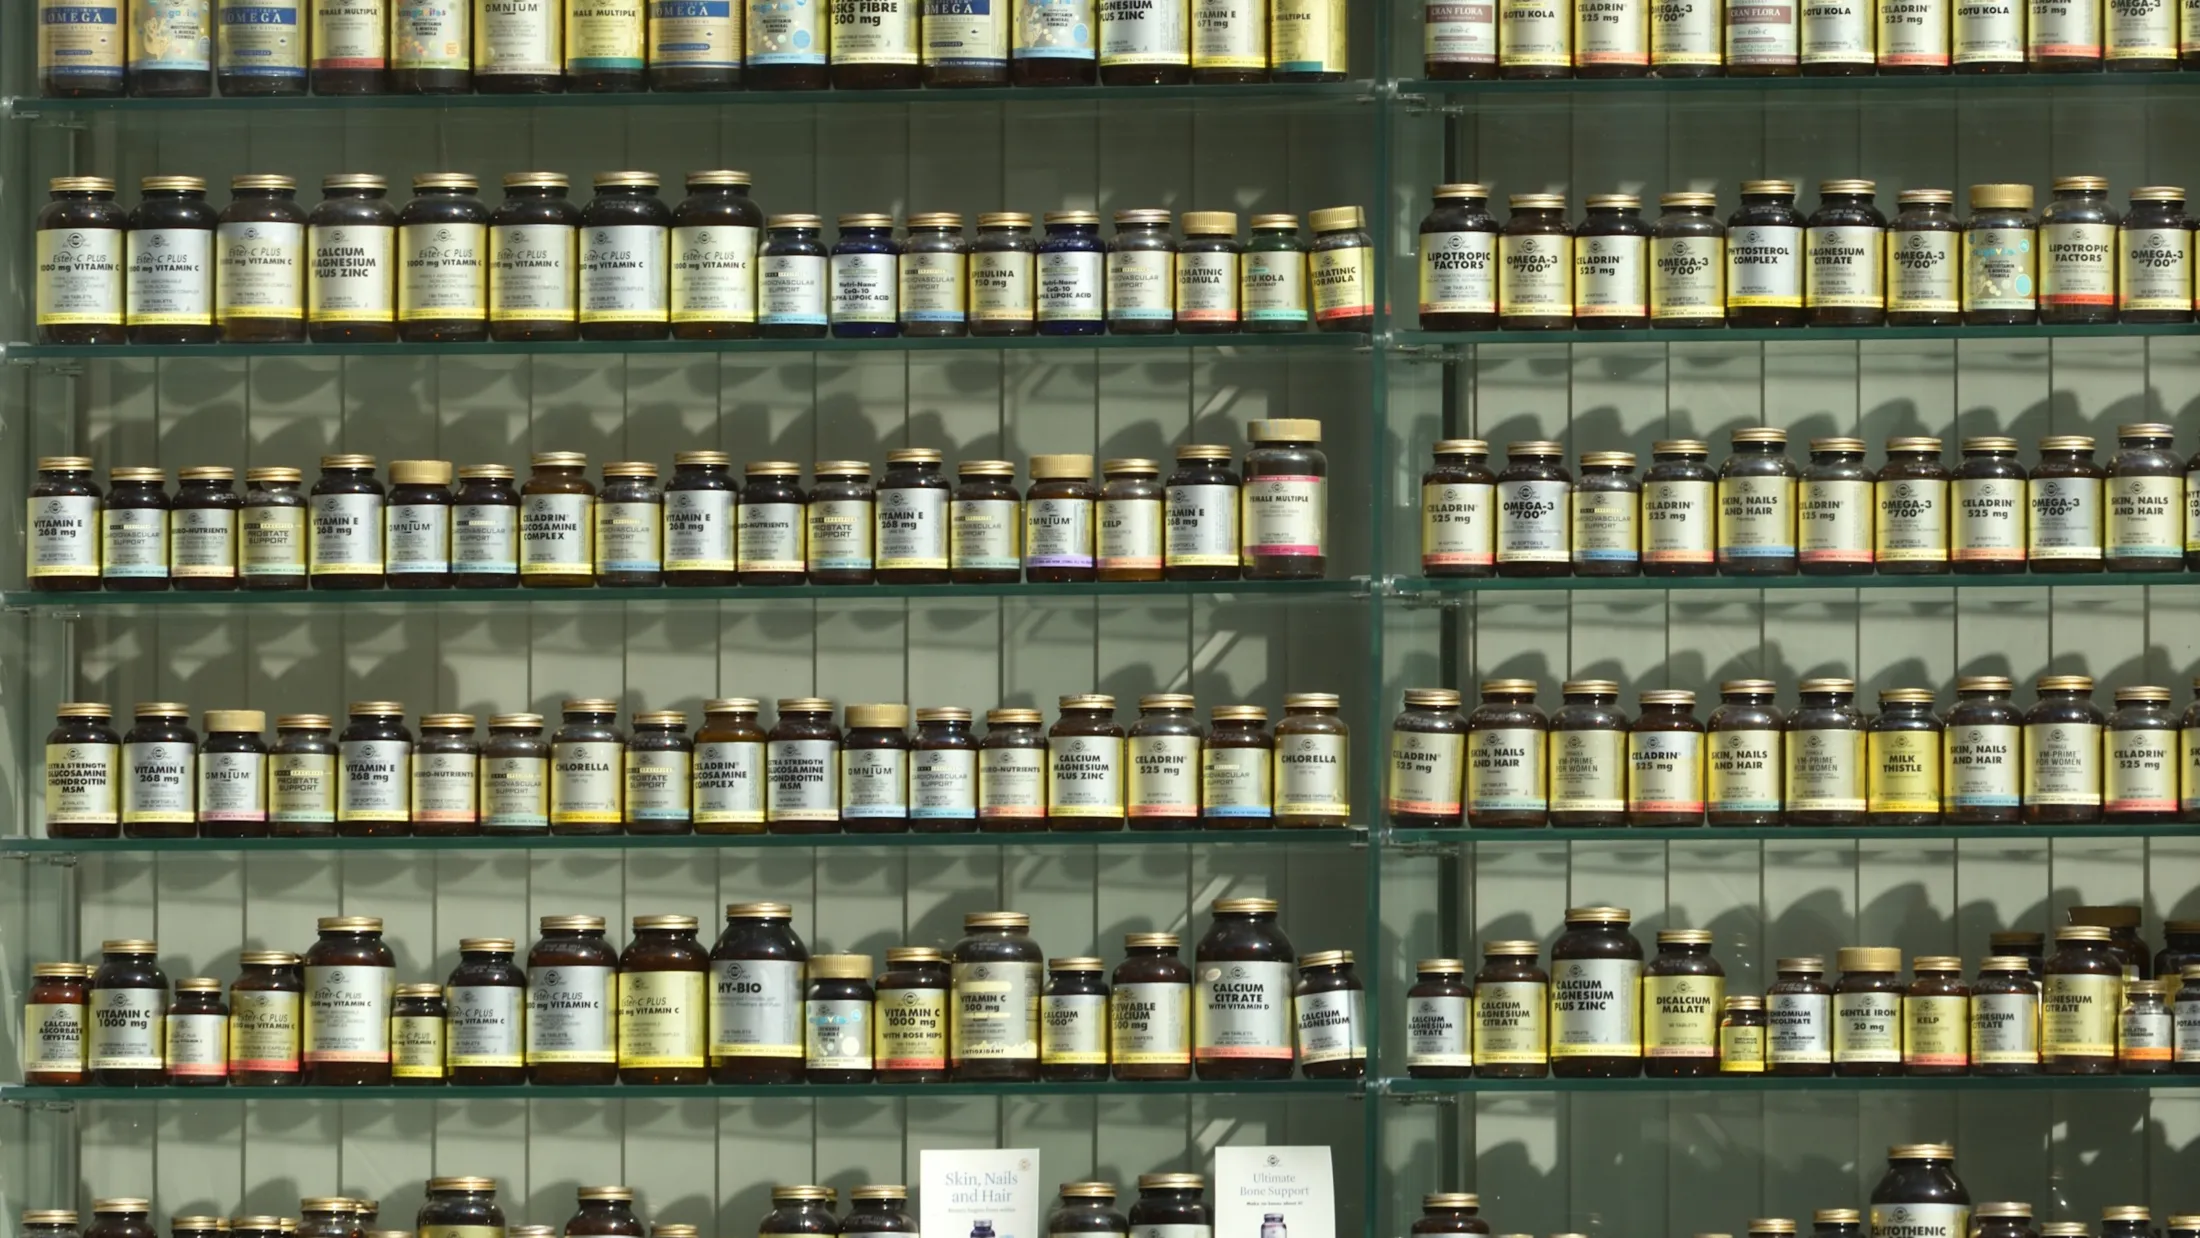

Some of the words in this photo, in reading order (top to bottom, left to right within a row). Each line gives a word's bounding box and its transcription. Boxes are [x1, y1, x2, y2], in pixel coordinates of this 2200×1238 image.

[657, 7, 708, 15] OMEGA
[860, 3, 897, 12] FIBRE
[925, 5, 973, 13] OMEGA
[48, 13, 102, 22] OMEGA
[835, 14, 853, 24] 500
[860, 15, 880, 26] mg
[1603, 14, 1619, 23] mg
[1907, 17, 1923, 25] mg
[317, 248, 364, 257] CALCIUM
[1729, 248, 1789, 256] PHYTOSTEROL
[2049, 244, 2108, 252] LIPOTROPIC
[454, 249, 473, 257] PLUS
[610, 251, 630, 260] PLUS
[683, 249, 710, 261] Ester-C
[714, 252, 734, 260] PLUS
[1428, 252, 1491, 262] LIPOTROPIC
[1894, 252, 1945, 260] OMEGA-3
[2131, 250, 2184, 259] OMEGA-3
[1507, 256, 1558, 264] OMEGA-3
[1658, 257, 1709, 266] OMEGA-3
[1734, 256, 1778, 264] COMPLEX
[2055, 254, 2102, 262] FACTORS
[1434, 261, 1484, 270] FACTORS
[315, 269, 338, 278] PLUS
[341, 269, 368, 277] ZINC
[1599, 267, 1615, 276] mg
[1722, 497, 1743, 506] SKIN,
[1746, 496, 1778, 504] NAILS
[1882, 500, 1932, 509] OMEGA-3
[2032, 498, 2080, 507] OMEGA-3
[2111, 497, 2134, 505] SKIN,
[1504, 502, 1554, 511] OMEGA-3
[1724, 508, 1743, 516] AND
[1747, 507, 1772, 515] HAIR
[1968, 510, 1988, 518] 525
[1992, 512, 2008, 520] mg
[34, 519, 74, 528] VITAMIN
[1432, 514, 1450, 522] 525
[1454, 515, 1470, 524] mg
[669, 523, 686, 531] 268
[688, 524, 704, 532] mg
[60, 530, 76, 538] mg
[1950, 746, 1973, 755] SKIN,
[1976, 746, 2007, 754] NAILS
[2039, 750, 2077, 758] VM-PRIME
[1281, 755, 1336, 764] CHLORELLA
[1889, 755, 1915, 763] MILK
[1953, 756, 1972, 765] AND
[1974, 756, 2002, 764] HAIR
[2036, 758, 2049, 766] FOR
[2052, 758, 2081, 766] WOMEN
[556, 763, 609, 772] CHLORELLA
[2145, 761, 2160, 770] mg
[1163, 767, 1179, 776] mg
[140, 775, 160, 783] 268
[164, 776, 179, 784] mg
[718, 982, 762, 993] HY-BIO
[1214, 984, 1264, 992] CALCIUM
[1556, 980, 1602, 990] CALCIUM
[562, 992, 583, 1000] PLUS
[1215, 994, 1262, 1002] CITRATE
[1656, 997, 1711, 1005] DICALCIUM
[1555, 1002, 1575, 1011] PLUS
[1578, 1001, 1606, 1010] ZINC
[1662, 1005, 1705, 1013] MALATE
[96, 1010, 141, 1019] VITAMIN
[145, 1010, 150, 1018] C
[884, 1008, 931, 1017] VITAMIN
[935, 1008, 940, 1017] C
[1302, 1009, 1340, 1020] CALCIUM
[1477, 1010, 1530, 1018] MAGNESIUM
[1840, 1009, 1871, 1017] GENTLE
[1874, 1009, 1896, 1017] IRON
[270, 1014, 288, 1022] PLUS
[1483, 1018, 1519, 1026] CITRATE
[99, 1019, 126, 1027] 1000
[131, 1020, 147, 1029] mg
[889, 1018, 915, 1026] 1000
[920, 1019, 936, 1028] mg
[1854, 1023, 1866, 1031] 20
[1870, 1024, 1884, 1032] mg
[945, 1171, 981, 1187] Skin,
[985, 1170, 1018, 1185] Nails
[1253, 1173, 1295, 1183] Ultimate
[952, 1189, 978, 1203] and
[983, 1188, 1012, 1203] Hair
[1240, 1186, 1265, 1196] Bone
[1268, 1186, 1309, 1197] Support
